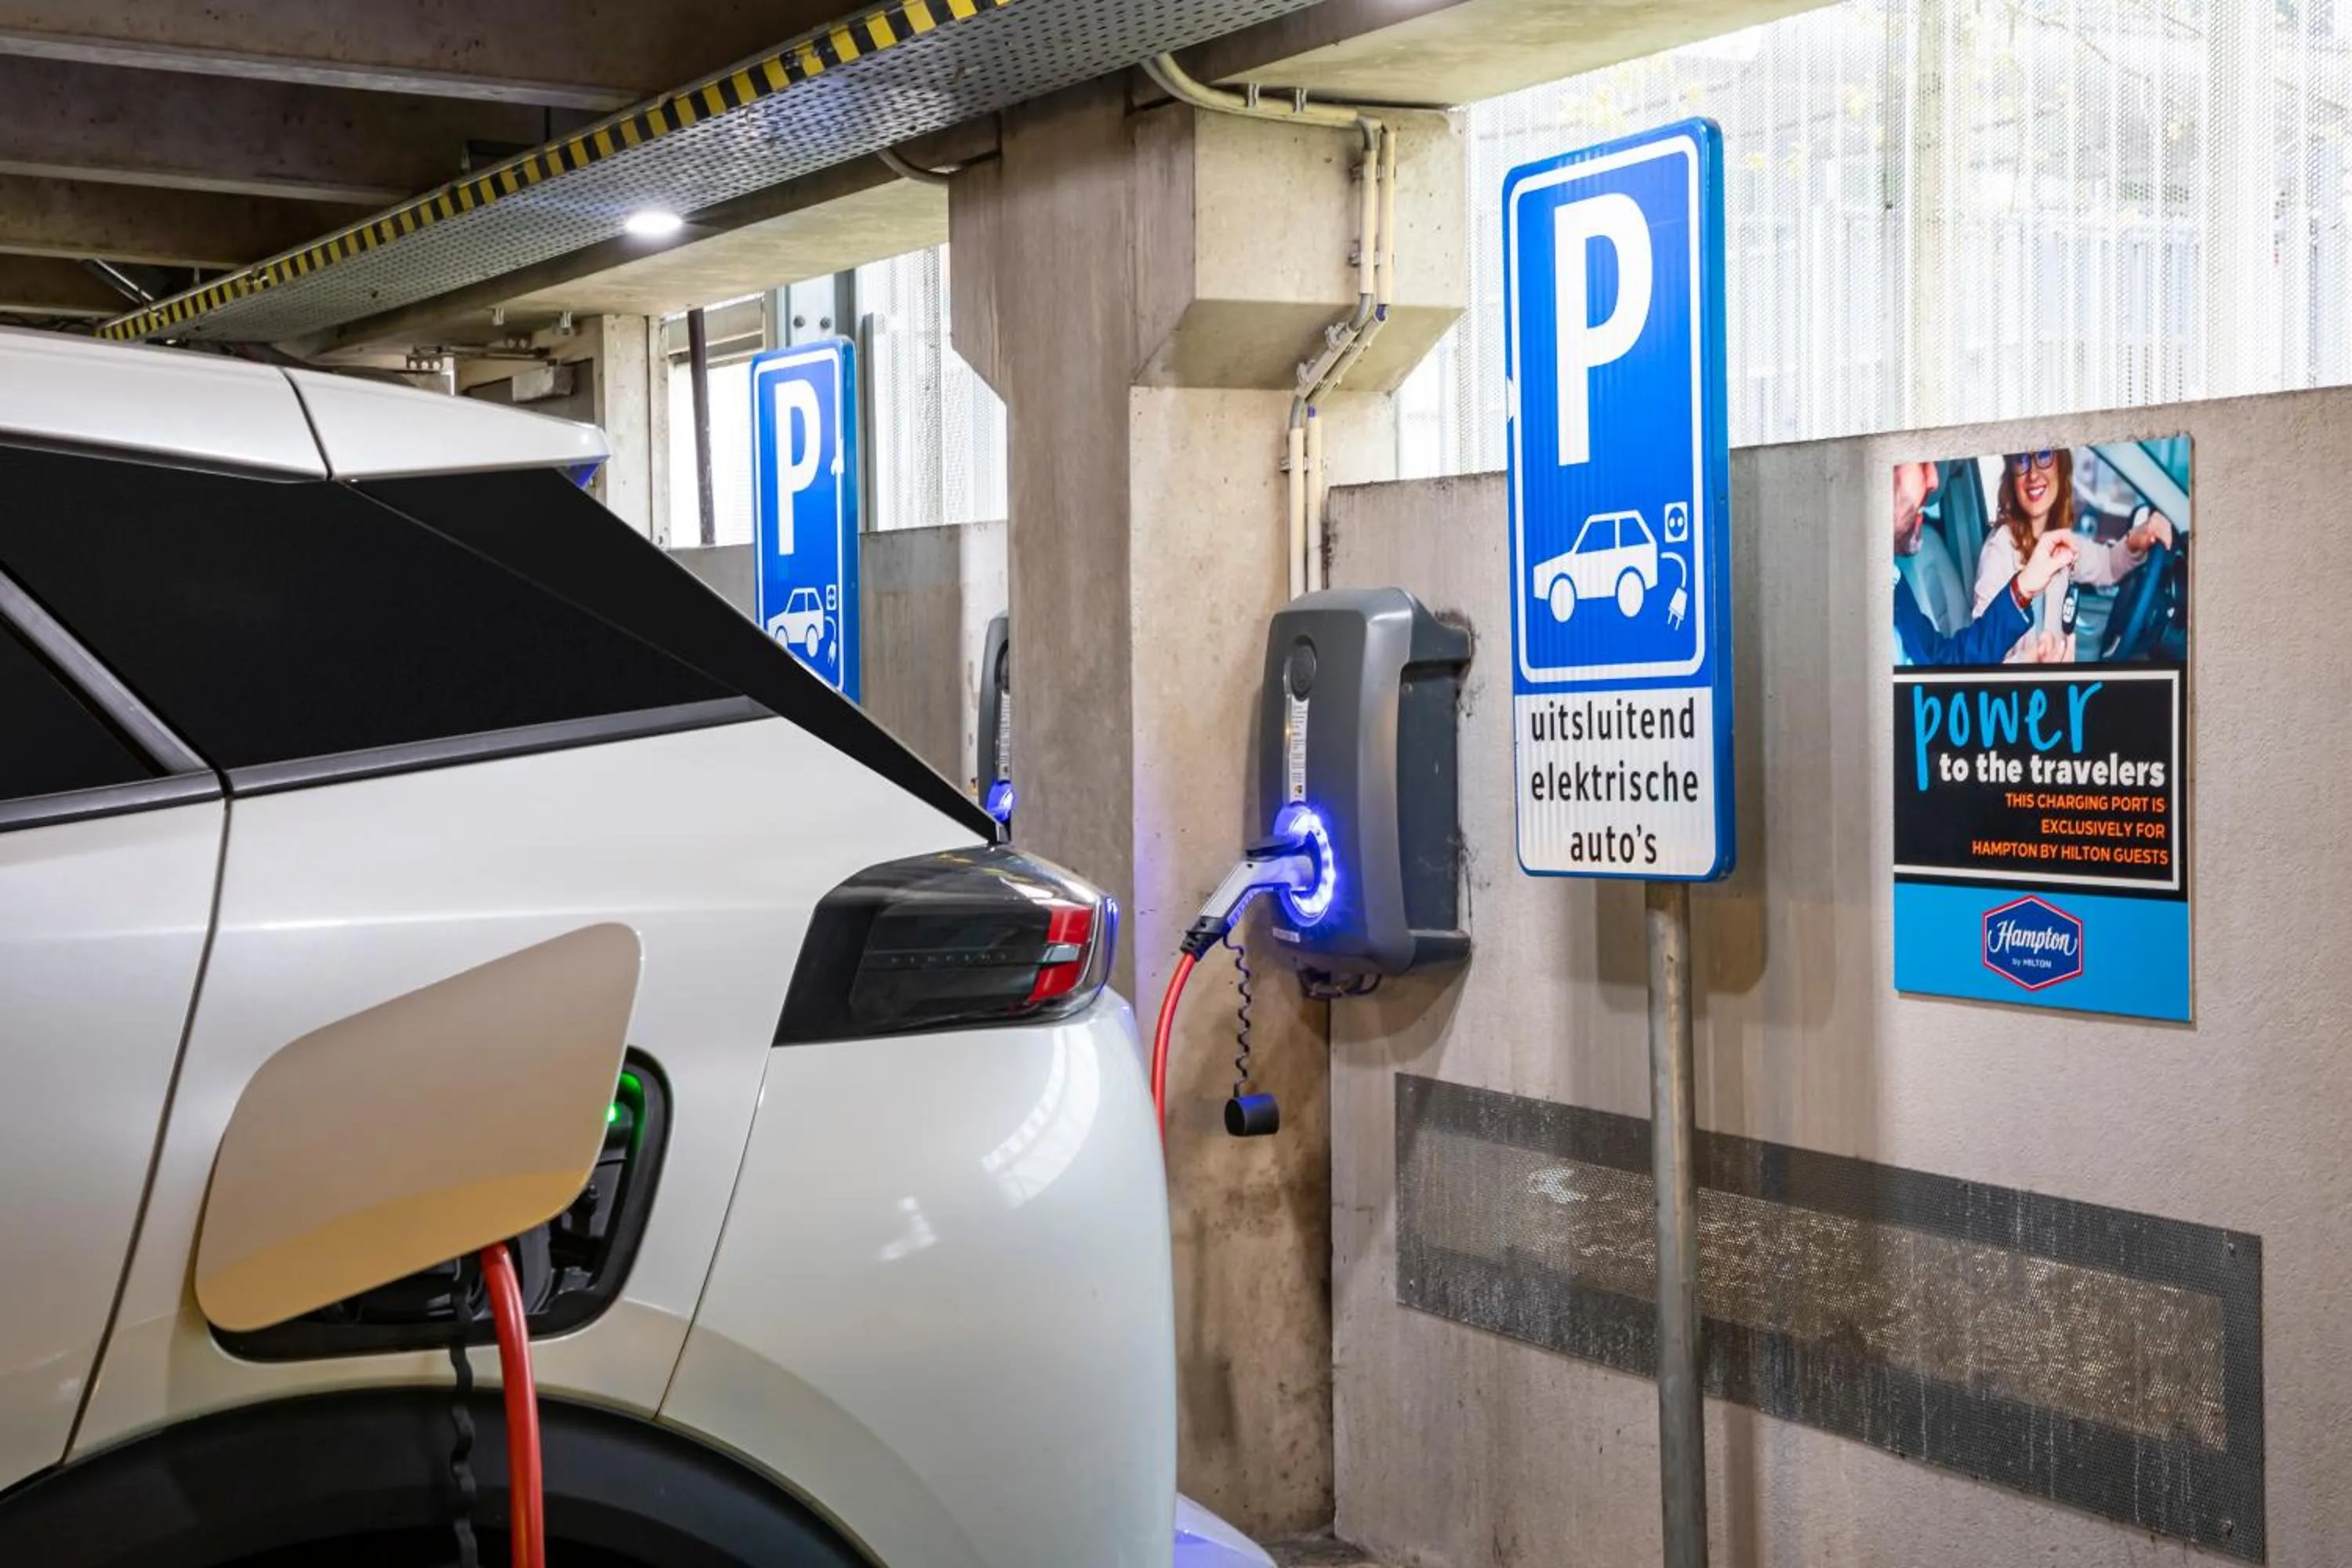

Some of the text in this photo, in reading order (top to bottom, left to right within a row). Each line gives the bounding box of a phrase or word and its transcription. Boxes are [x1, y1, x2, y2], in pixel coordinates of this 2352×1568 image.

[1554, 192, 1653, 466] P
[775, 379, 821, 555] P
[1531, 696, 1695, 742] uitsluitend
[1913, 681, 2103, 791] power
[1531, 759, 1699, 803] elektrische
[1940, 750, 2166, 787] to the travelers
[2005, 792, 2166, 813] THIS CHARGING PORT IS
[1570, 823, 1657, 864] auto's
[2041, 818, 2165, 839] EXCLUSIVELY FOR
[1971, 840, 2169, 866] HAMPTON BY HILTON GUESTS
[1987, 919, 2078, 956] Hampton
[2023, 959, 2052, 969] HILTON
